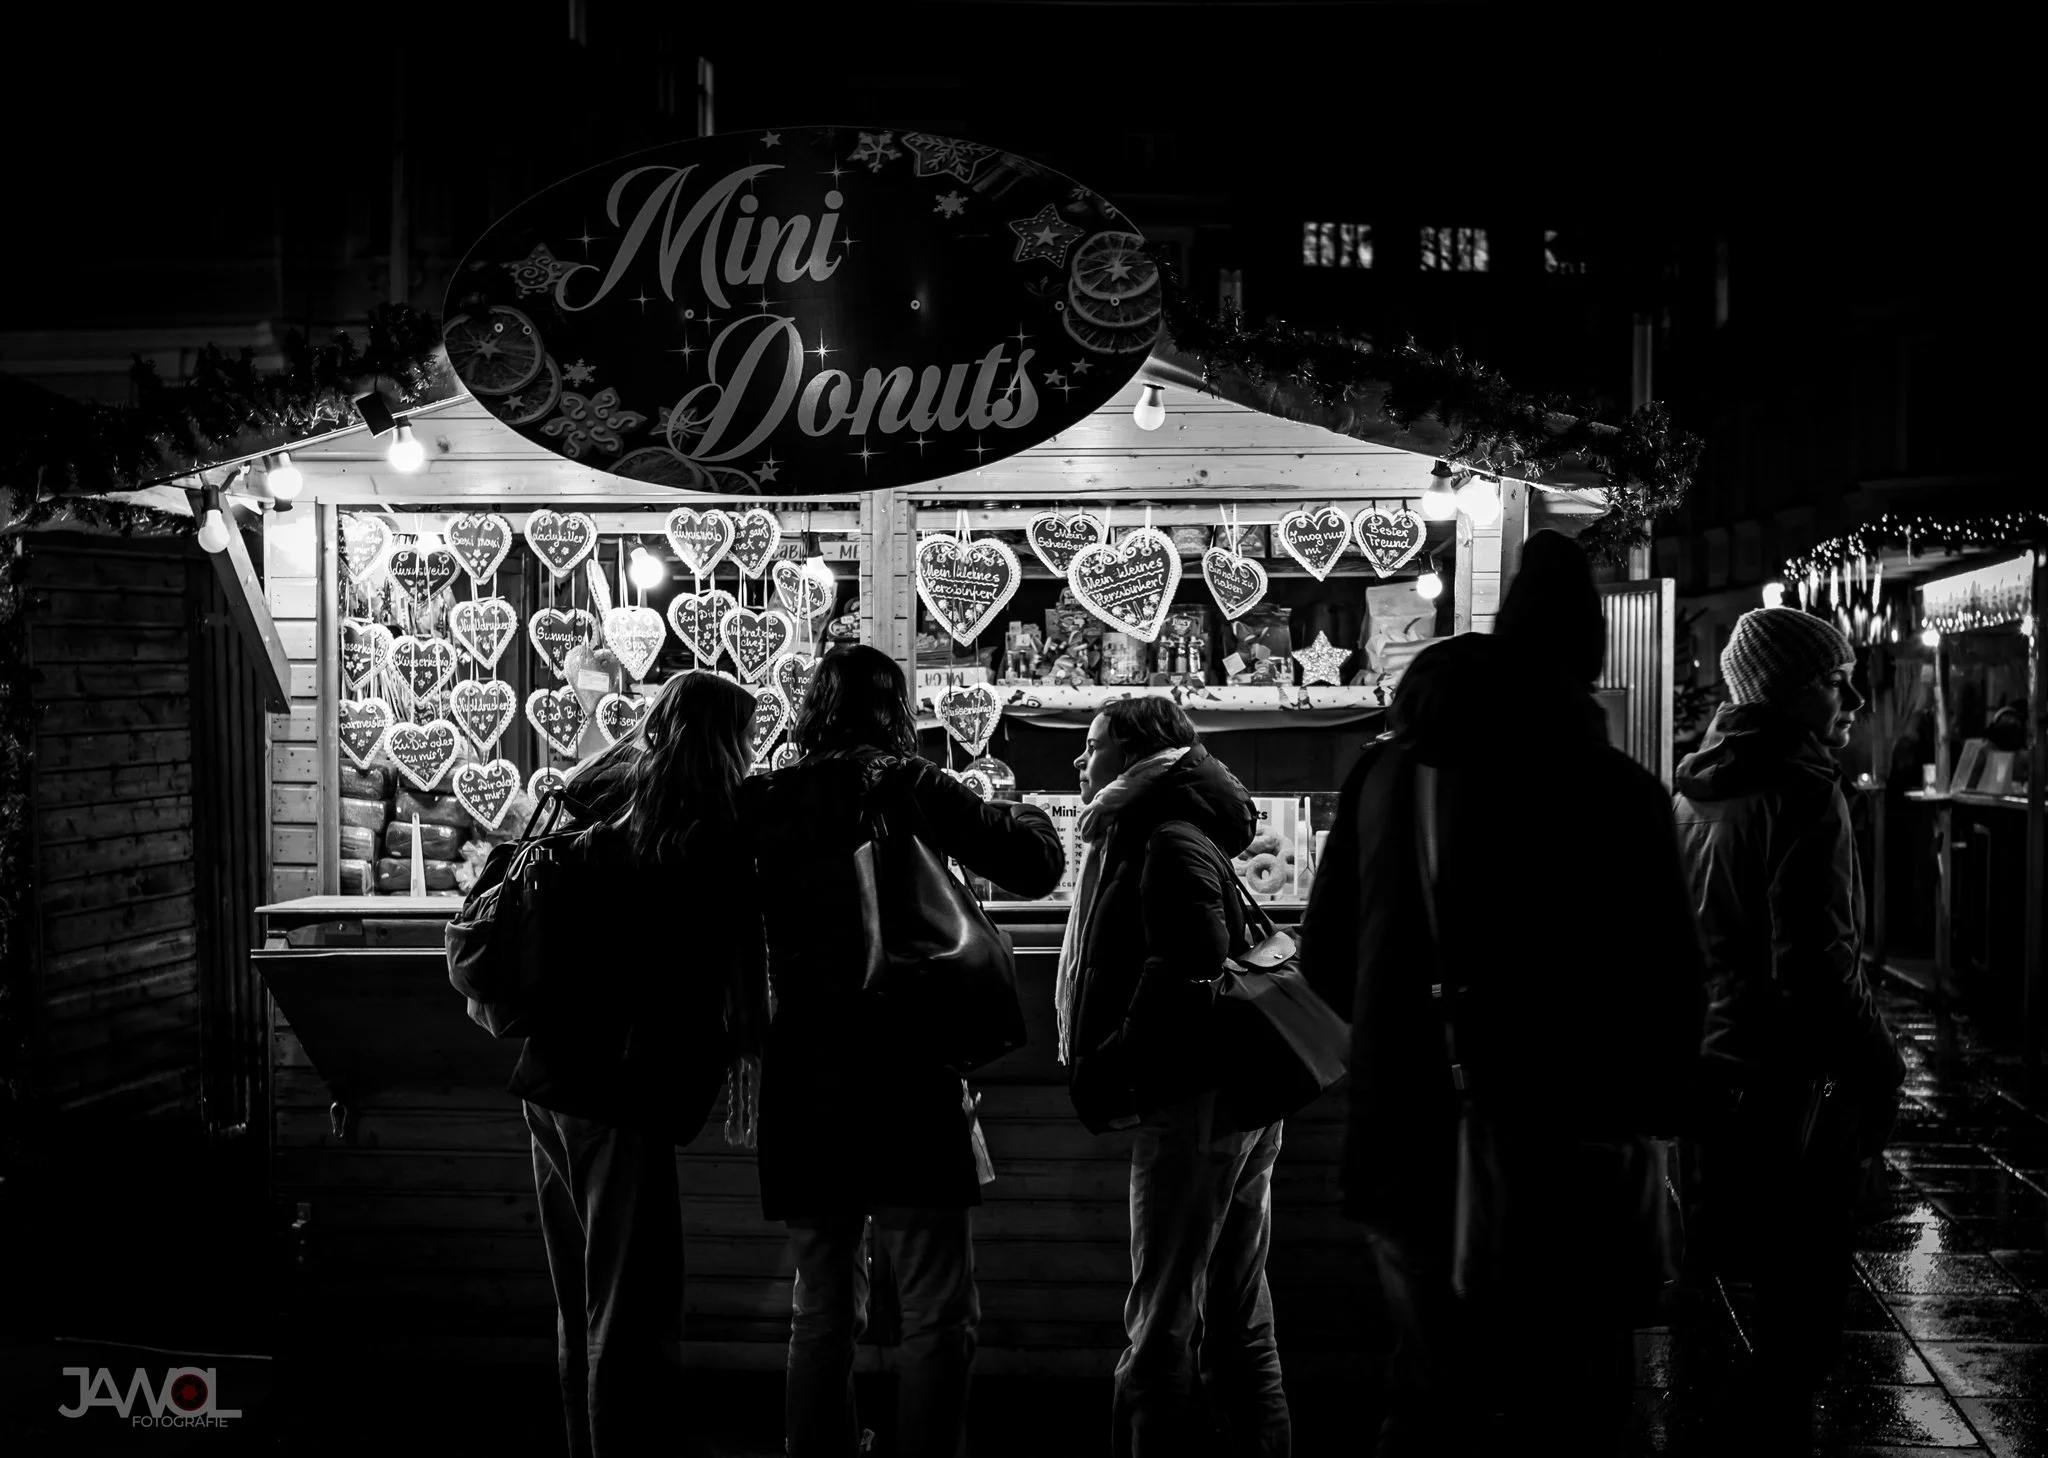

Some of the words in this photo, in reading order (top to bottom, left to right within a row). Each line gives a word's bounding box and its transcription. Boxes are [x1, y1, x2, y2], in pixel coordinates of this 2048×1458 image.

[555, 164, 845, 311] Mini
[667, 314, 1040, 463] Donuts
[1369, 523, 1410, 537] Bester
[1366, 533, 1412, 549] Freund
[923, 563, 952, 578] Mein
[957, 565, 1000, 583] kleines
[1082, 572, 1114, 593] Mein
[1117, 557, 1164, 579] kleines
[537, 706, 563, 723] Bad
